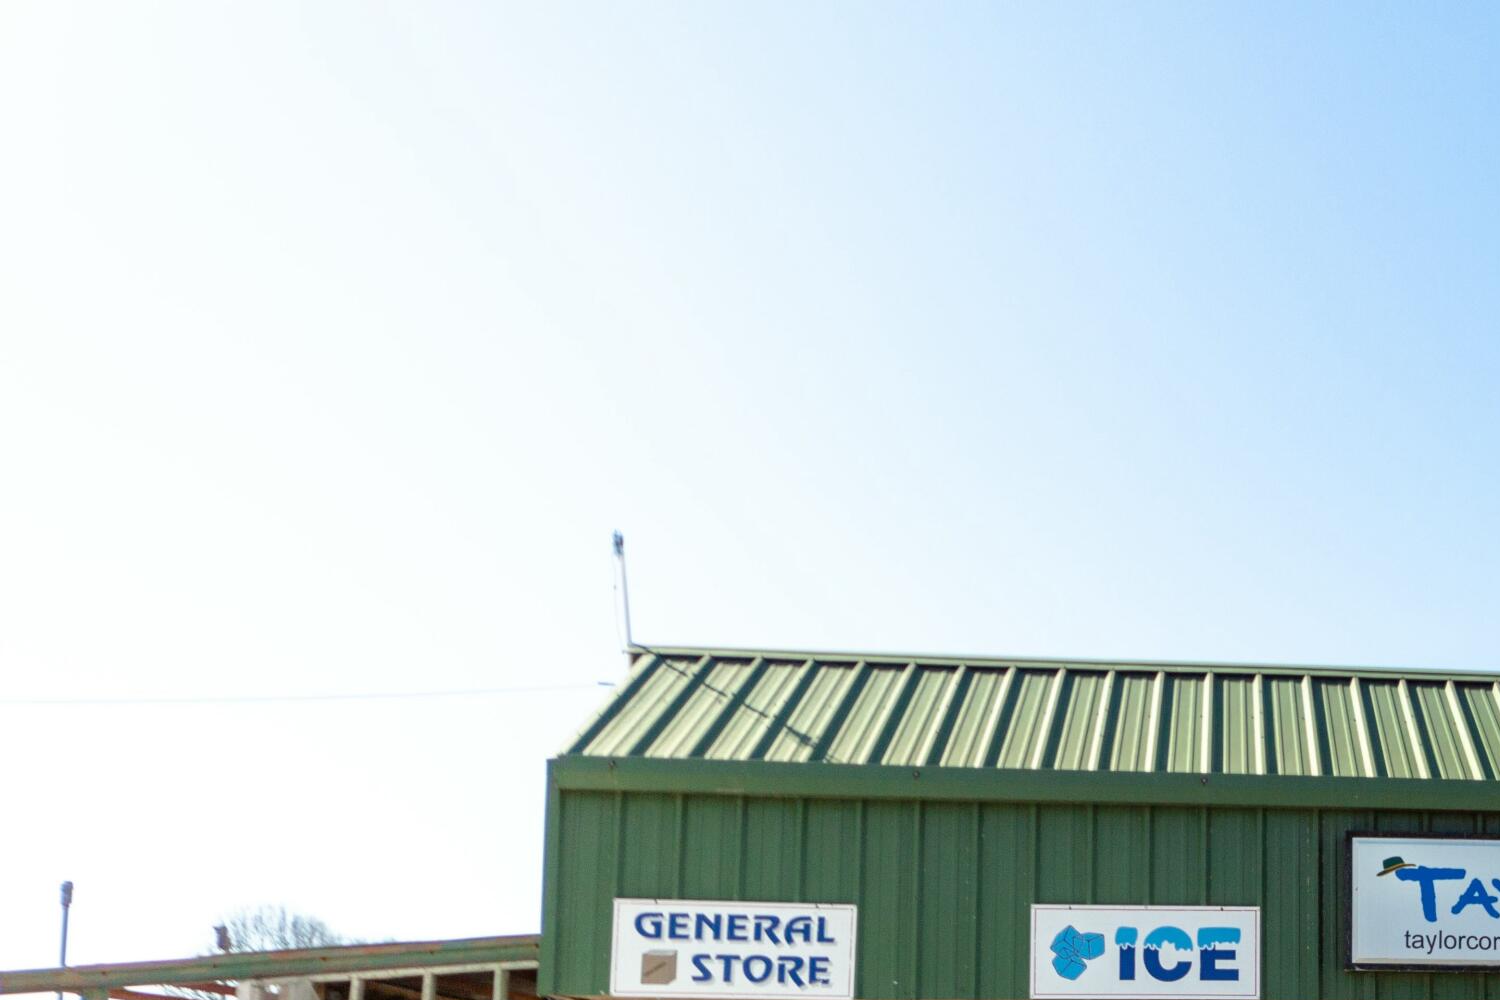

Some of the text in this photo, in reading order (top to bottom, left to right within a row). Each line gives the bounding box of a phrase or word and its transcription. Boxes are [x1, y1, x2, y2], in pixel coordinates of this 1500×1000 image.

[634, 912, 835, 945] GENERAL
[691, 954, 831, 987] STORE
[1115, 926, 1241, 982] ICE
